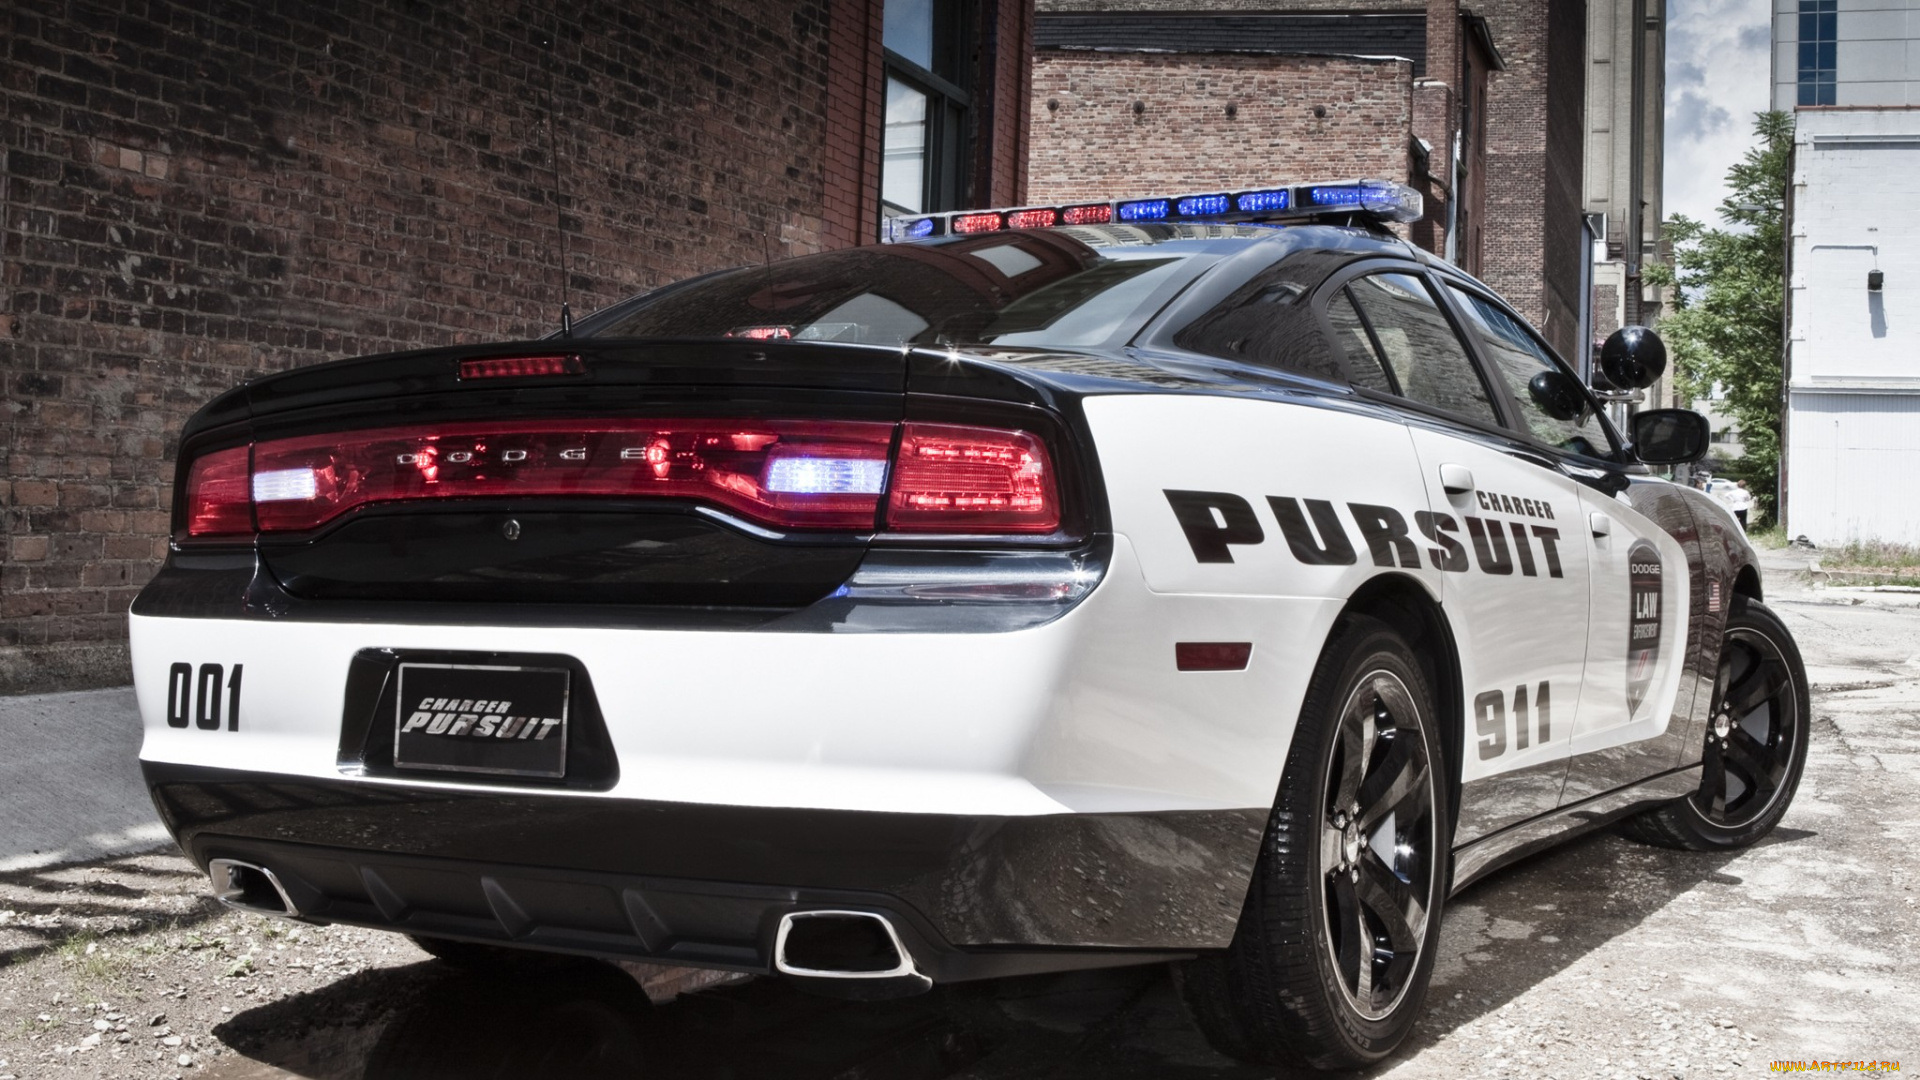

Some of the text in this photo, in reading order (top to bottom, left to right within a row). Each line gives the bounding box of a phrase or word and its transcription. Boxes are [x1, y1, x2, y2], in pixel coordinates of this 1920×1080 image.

[397, 447, 648, 464] DODGE
[1476, 490, 1555, 520] CHARGER
[1162, 488, 1564, 579] PURSUIT
[1632, 563, 1660, 574] DODGE
[1636, 592, 1658, 619] LAW
[167, 661, 244, 732] 001
[418, 697, 512, 713] CHARGER
[400, 711, 561, 741] PURSUIT
[1473, 679, 1551, 761] 911
